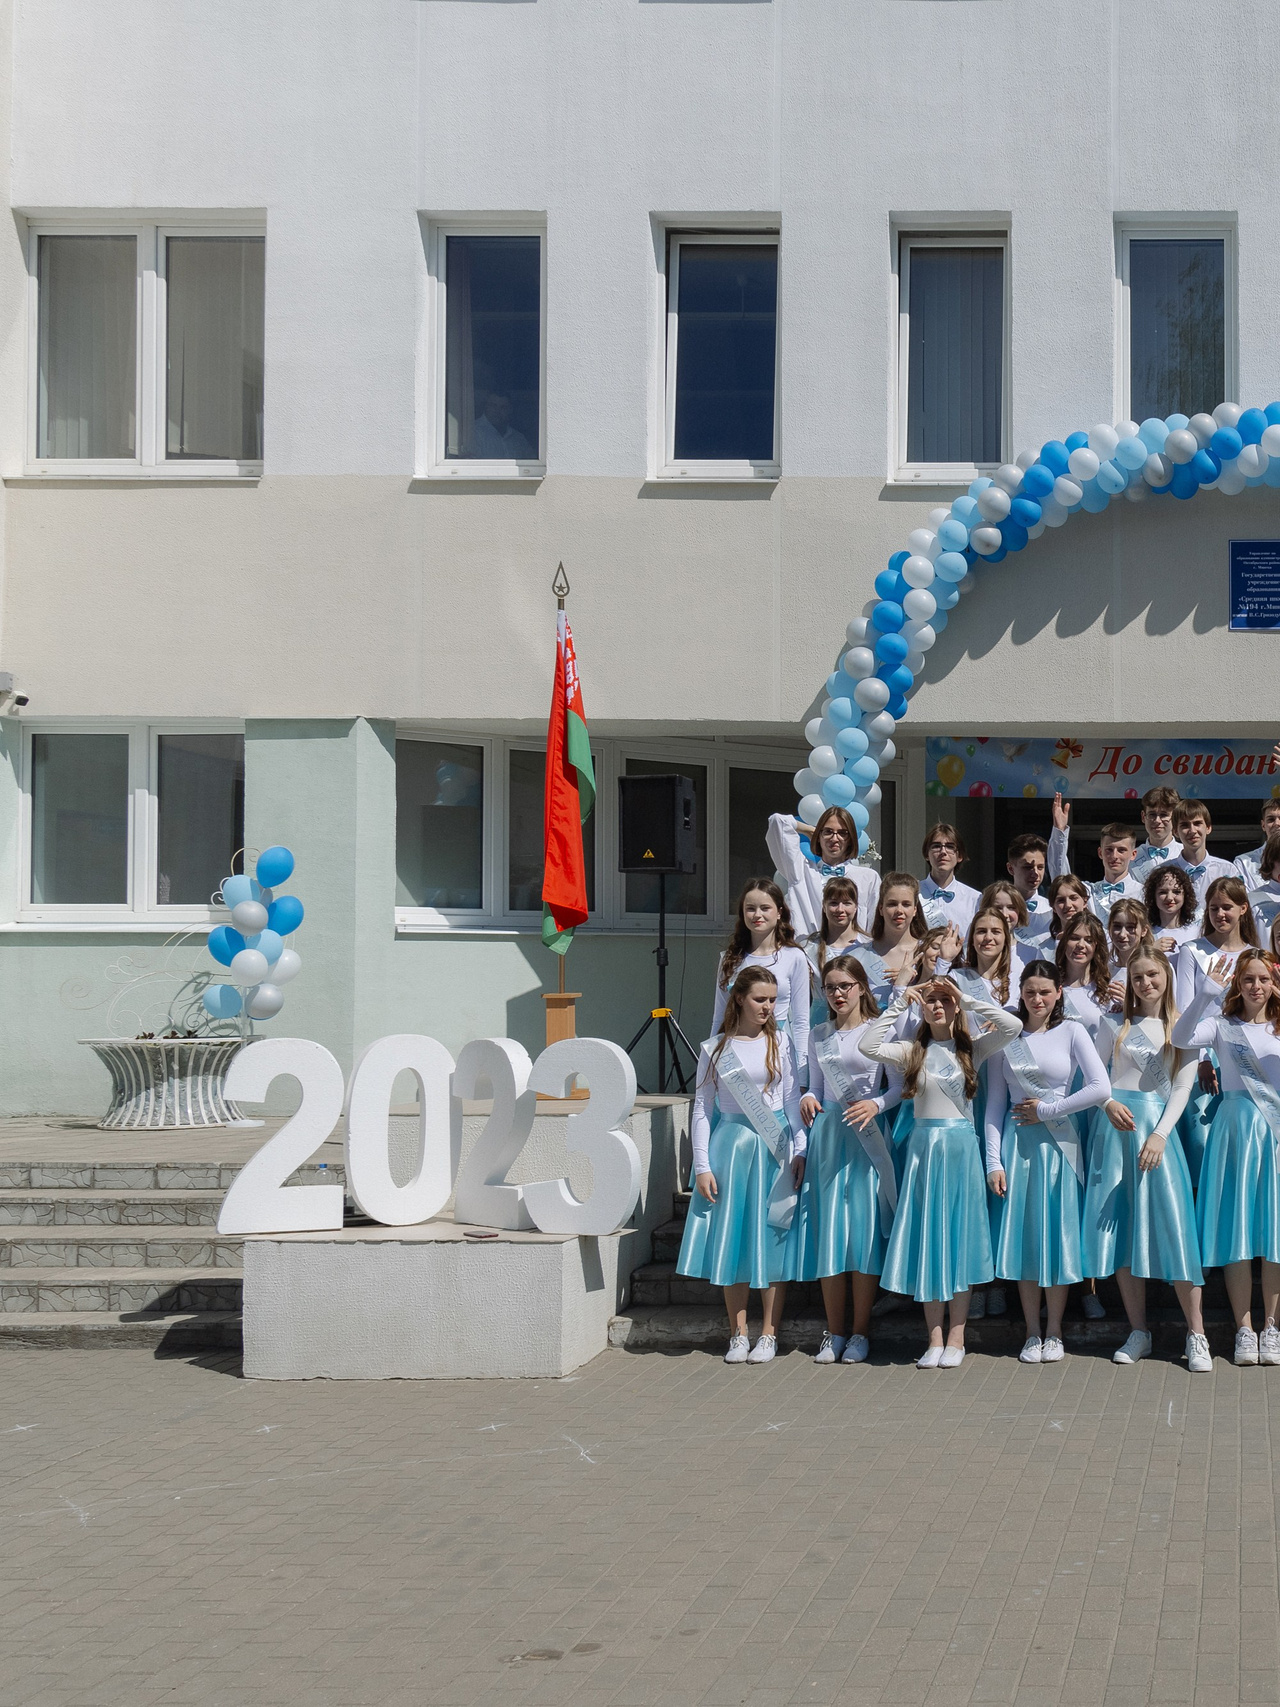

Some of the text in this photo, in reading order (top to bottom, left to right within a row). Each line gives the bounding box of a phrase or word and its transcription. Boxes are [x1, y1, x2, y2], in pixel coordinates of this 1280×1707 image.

[1087, 746, 1143, 782] До
[216, 1034, 643, 1235] 2023
[719, 1051, 790, 1153] Выпускница 2024
